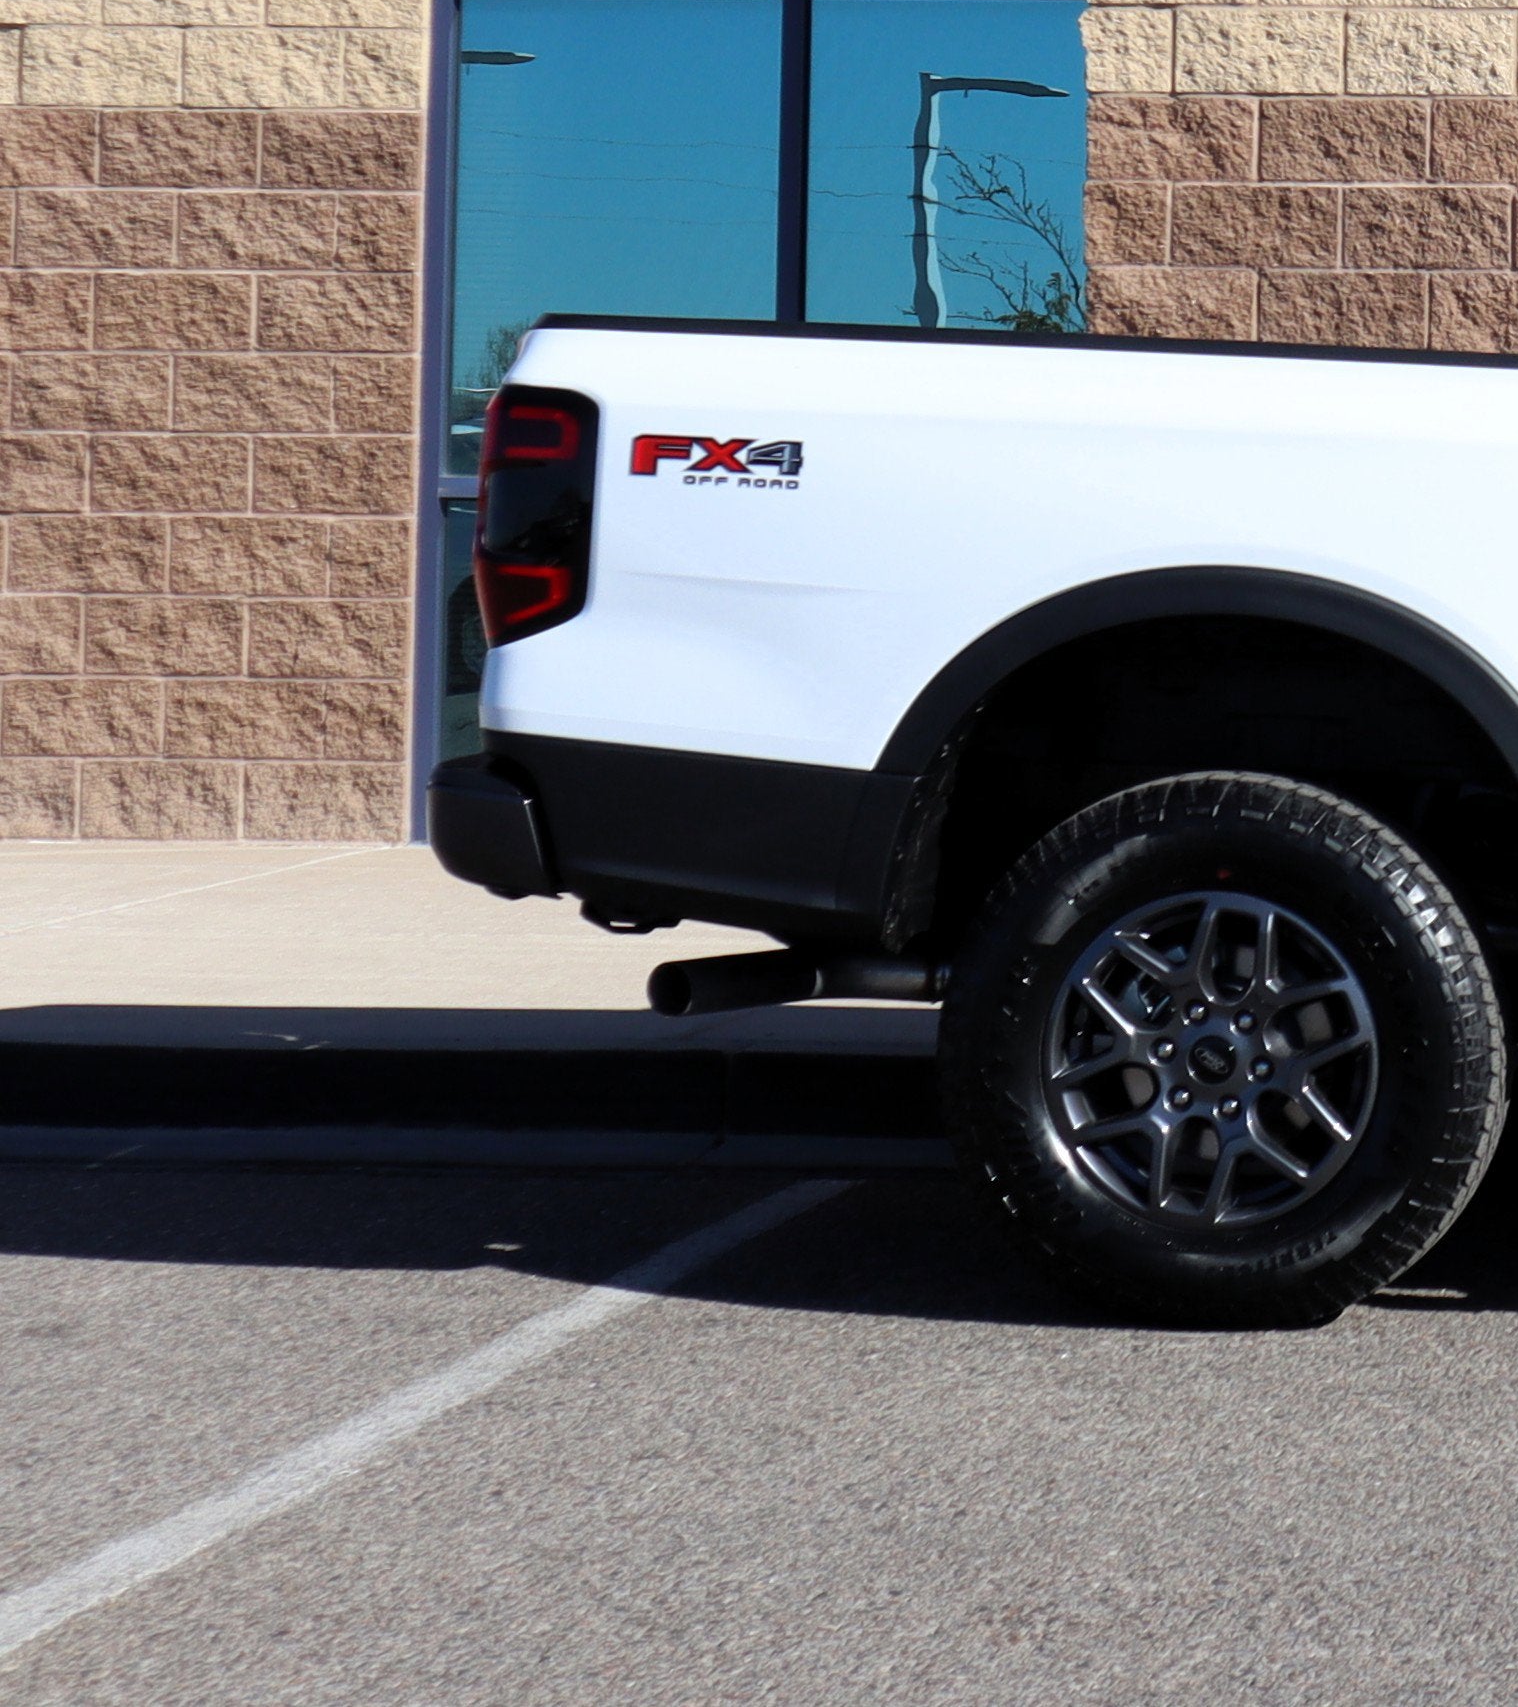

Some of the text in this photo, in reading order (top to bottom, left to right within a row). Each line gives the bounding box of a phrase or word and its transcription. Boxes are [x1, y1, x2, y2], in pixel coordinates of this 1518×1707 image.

[629, 434, 804, 476] FX4
[683, 475, 800, 490] OFF ROAD
